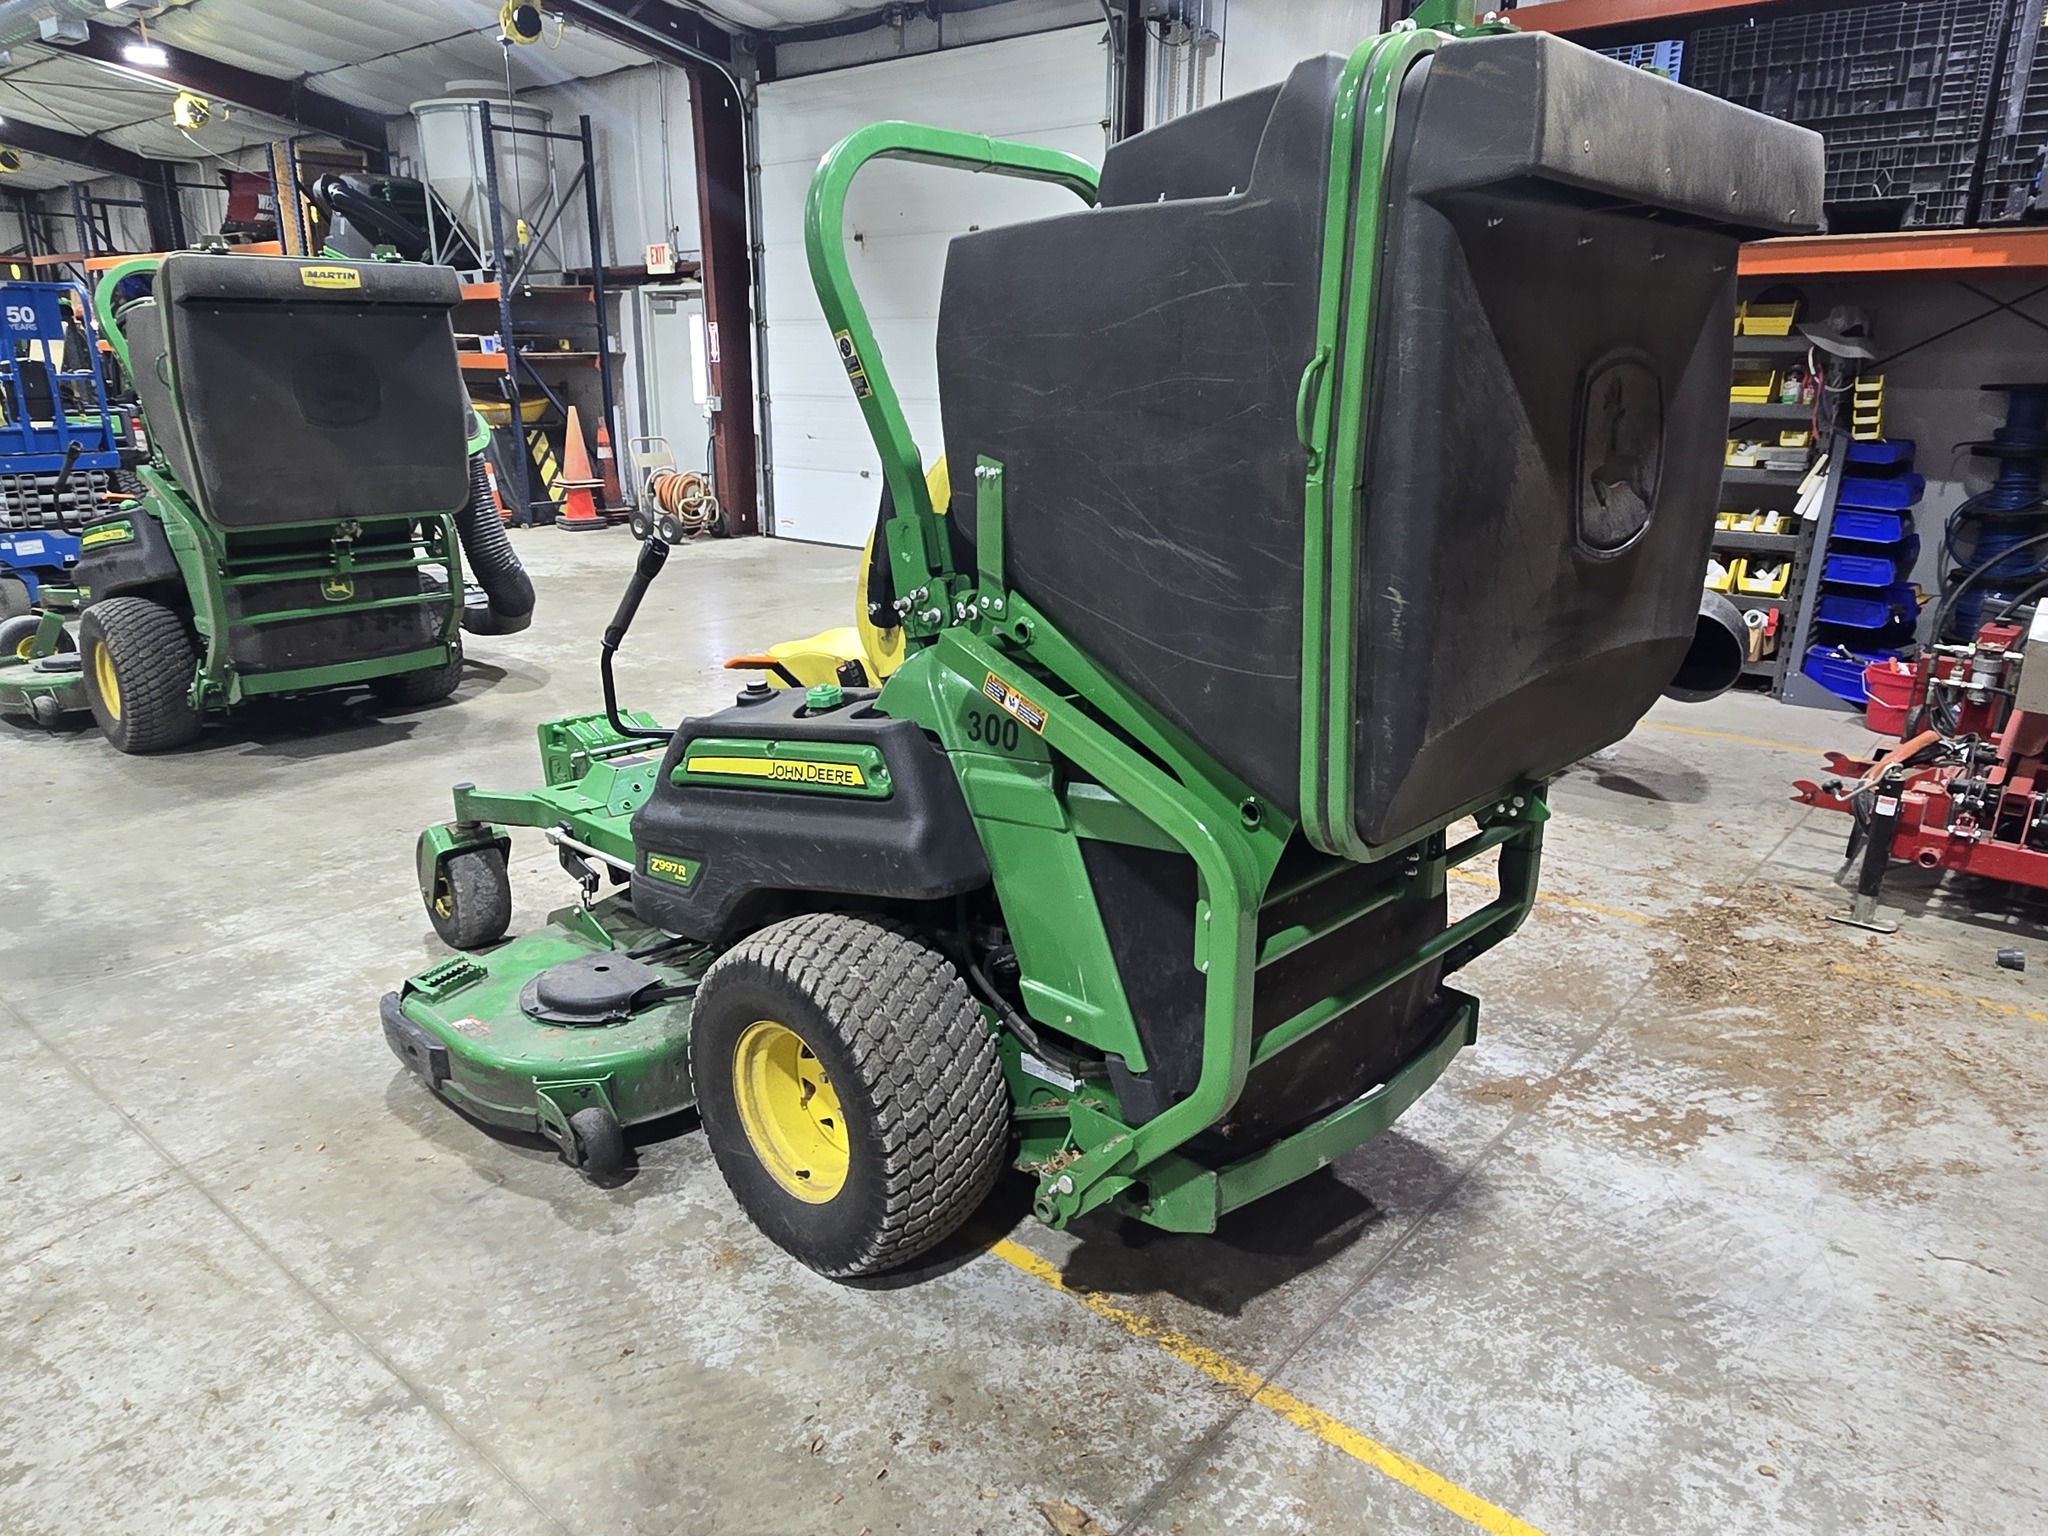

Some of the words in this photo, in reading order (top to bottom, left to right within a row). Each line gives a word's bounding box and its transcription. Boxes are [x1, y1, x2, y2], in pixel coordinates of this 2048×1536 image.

[650, 246, 666, 265] EXIT
[305, 271, 356, 280] MARTIN
[6, 306, 35, 323] 50
[8, 323, 38, 331] YEARS
[967, 711, 1019, 752] 300
[768, 762, 804, 778] JOHN
[807, 765, 854, 783] DEERE
[651, 858, 686, 876] Z997R
